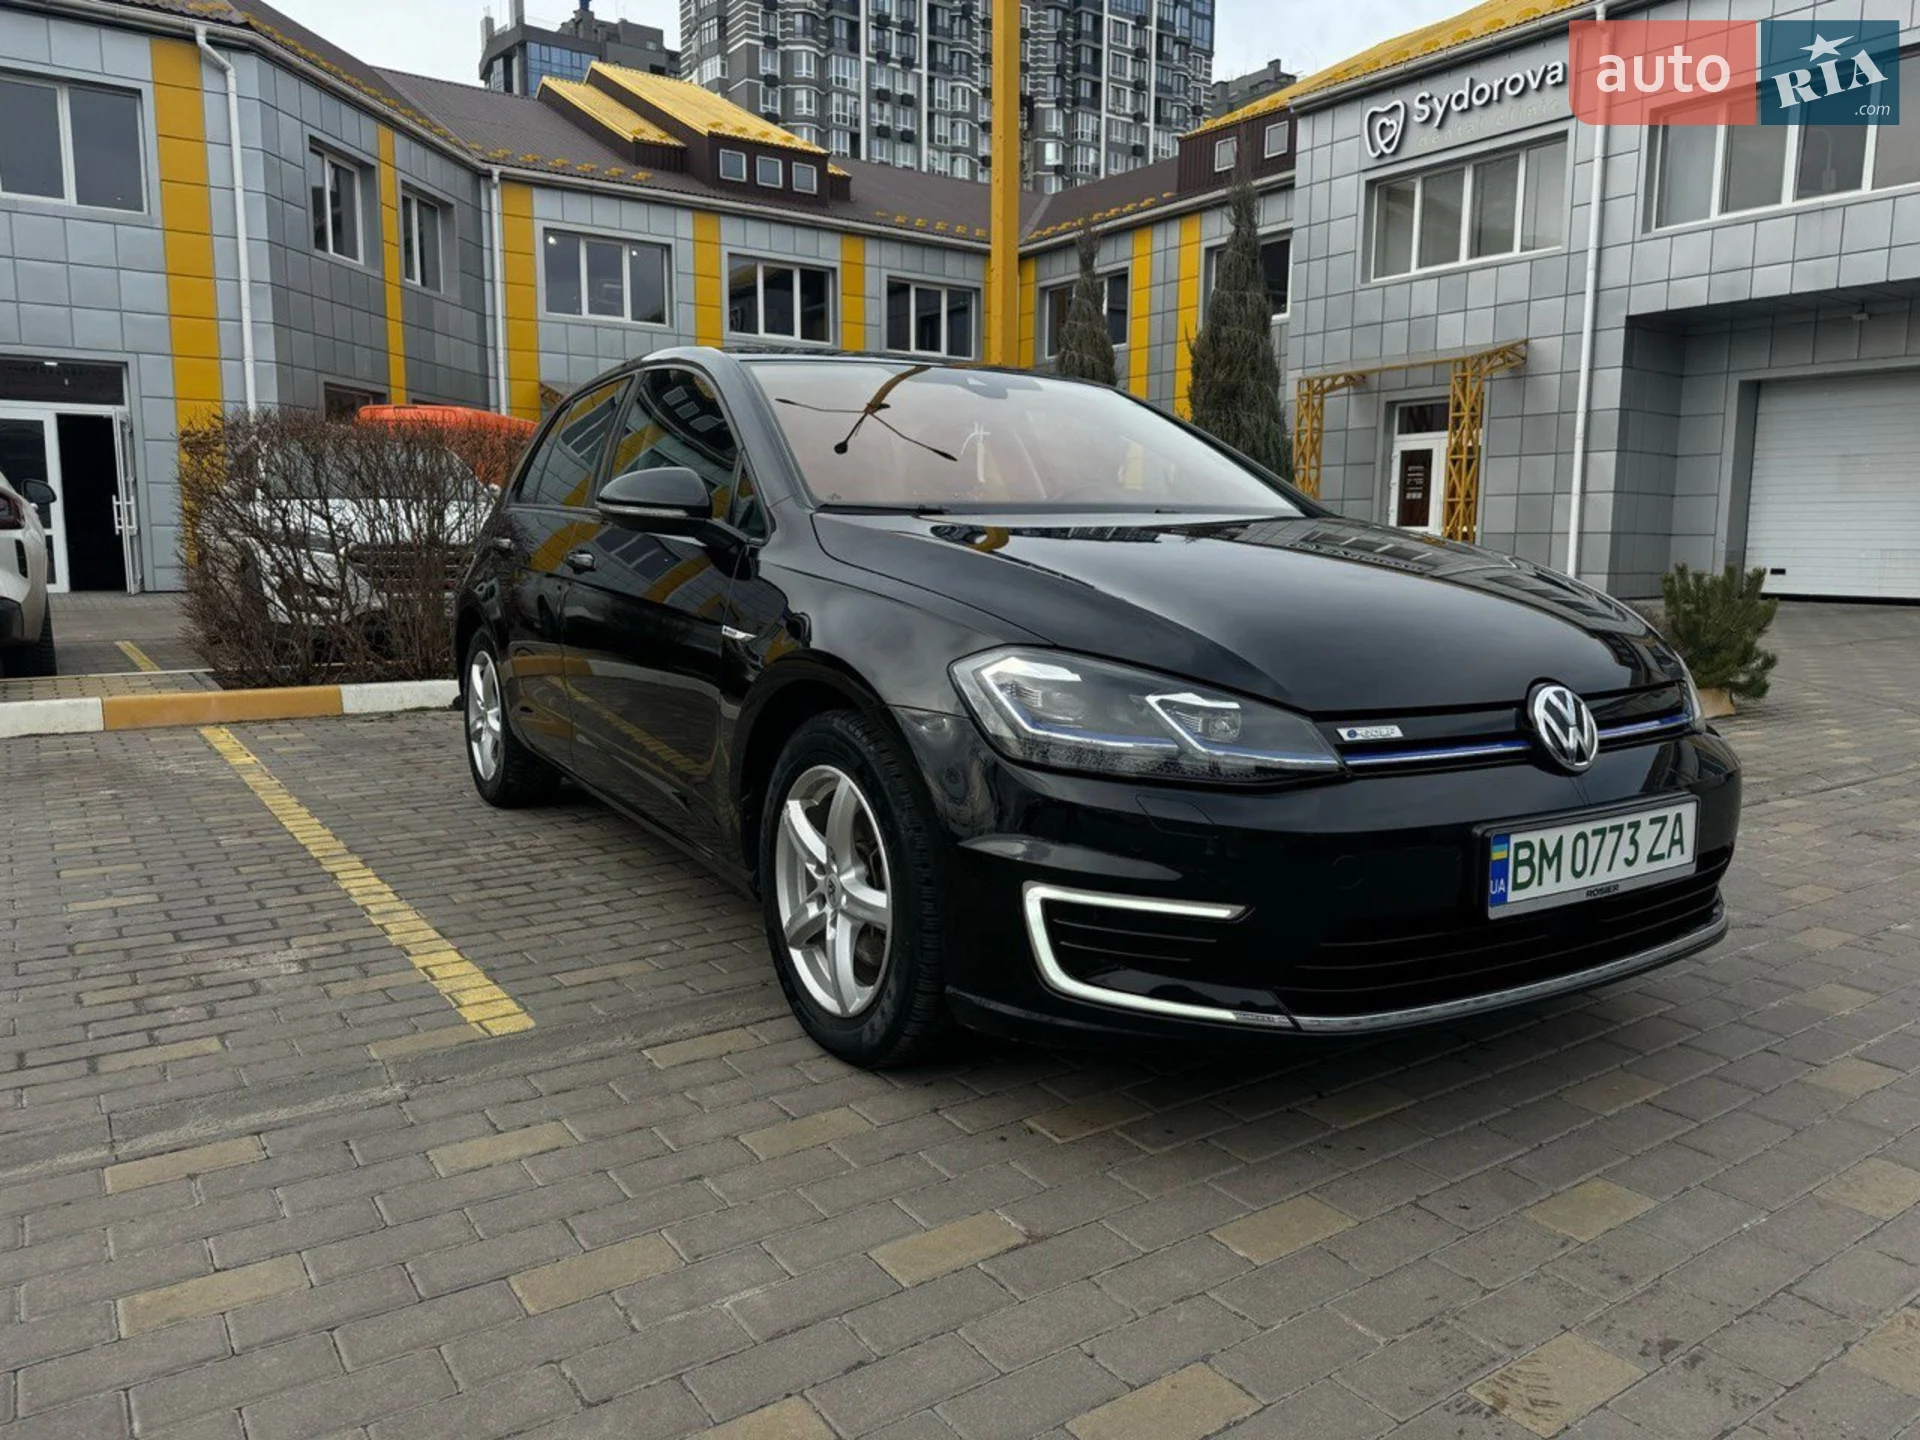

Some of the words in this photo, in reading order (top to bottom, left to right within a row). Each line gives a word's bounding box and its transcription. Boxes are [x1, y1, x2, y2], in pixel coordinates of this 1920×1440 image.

[1412, 60, 1564, 128] Sydorova
[1511, 835, 1563, 892] BM
[1571, 820, 1642, 879] 0773
[1647, 812, 1684, 863] ZA
[1490, 879, 1505, 894] UA
